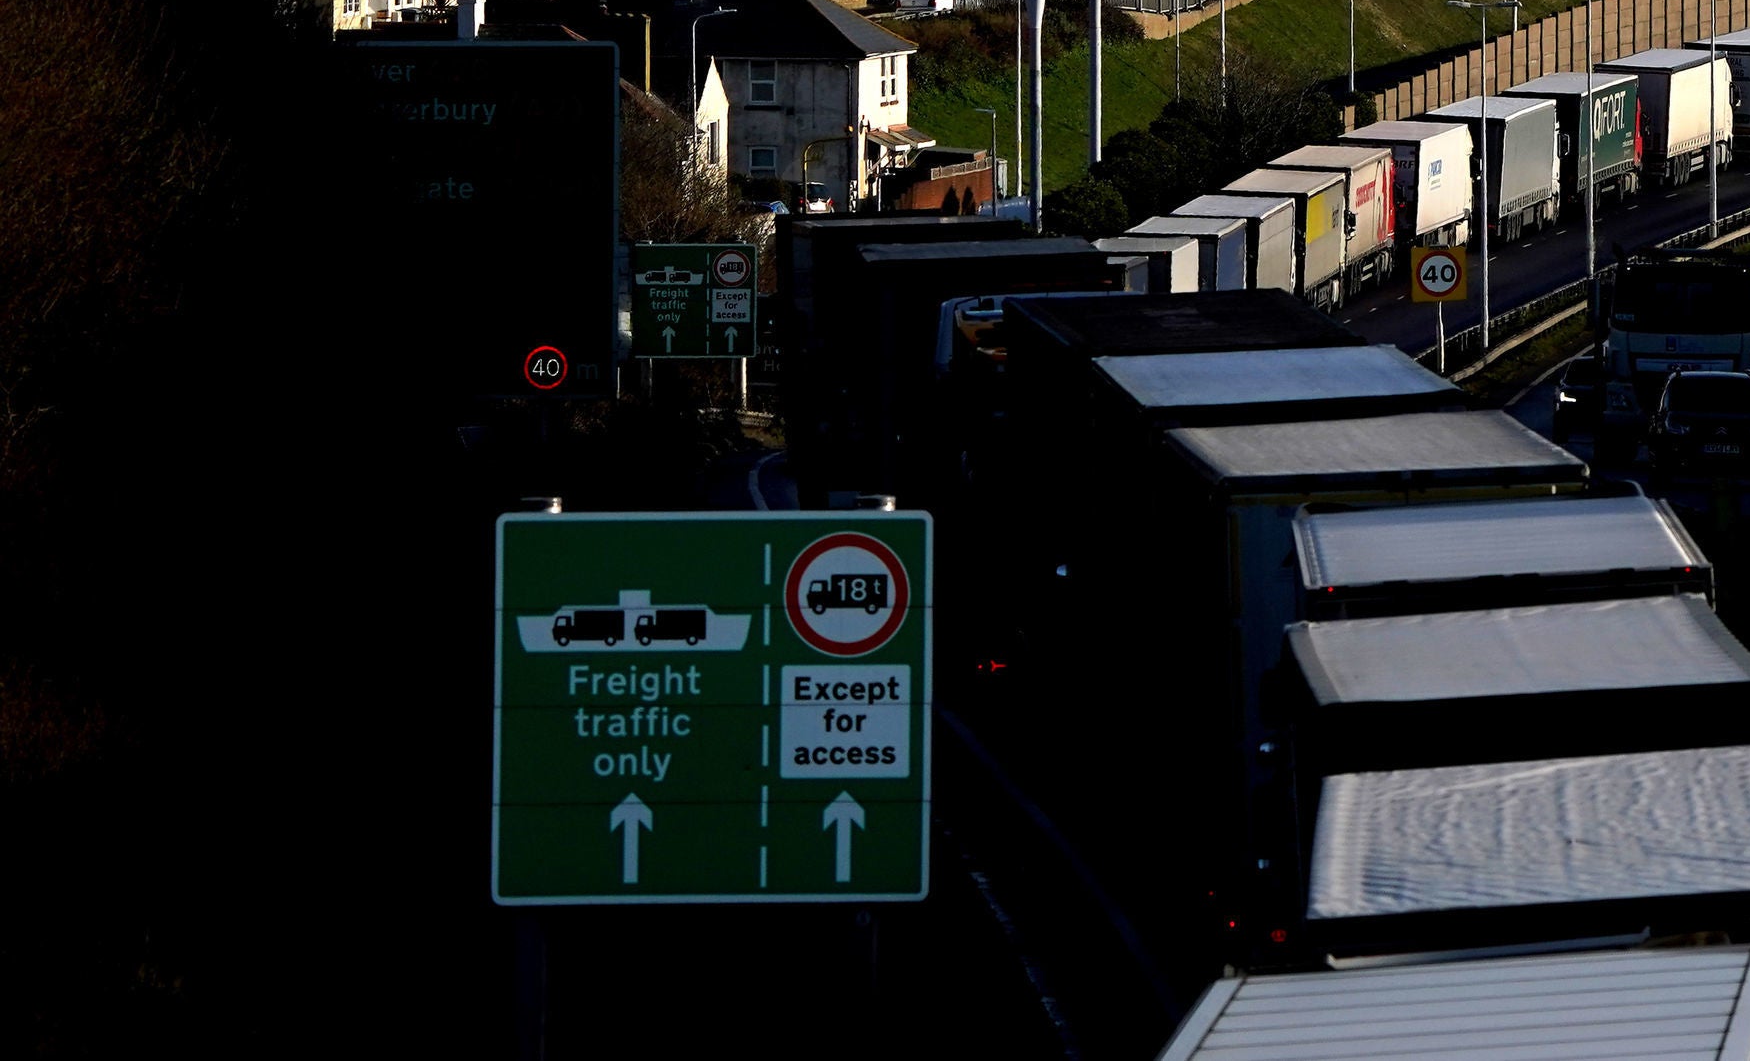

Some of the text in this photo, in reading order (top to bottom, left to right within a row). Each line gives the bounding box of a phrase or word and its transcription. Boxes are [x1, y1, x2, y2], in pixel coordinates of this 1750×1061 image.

[369, 64, 417, 82] ver
[394, 96, 497, 126] erbury
[1422, 264, 1456, 283] 40
[649, 288, 689, 300] Freight
[716, 292, 748, 301] Except
[651, 300, 687, 310] traffic
[724, 301, 738, 309] for
[656, 312, 681, 324] only
[716, 311, 746, 319] access
[532, 359, 560, 377] 40
[567, 664, 702, 702] Freight
[794, 676, 900, 705] Except
[574, 707, 692, 738] traffic
[823, 708, 867, 733] for
[794, 743, 896, 765] access
[592, 746, 673, 783] only
